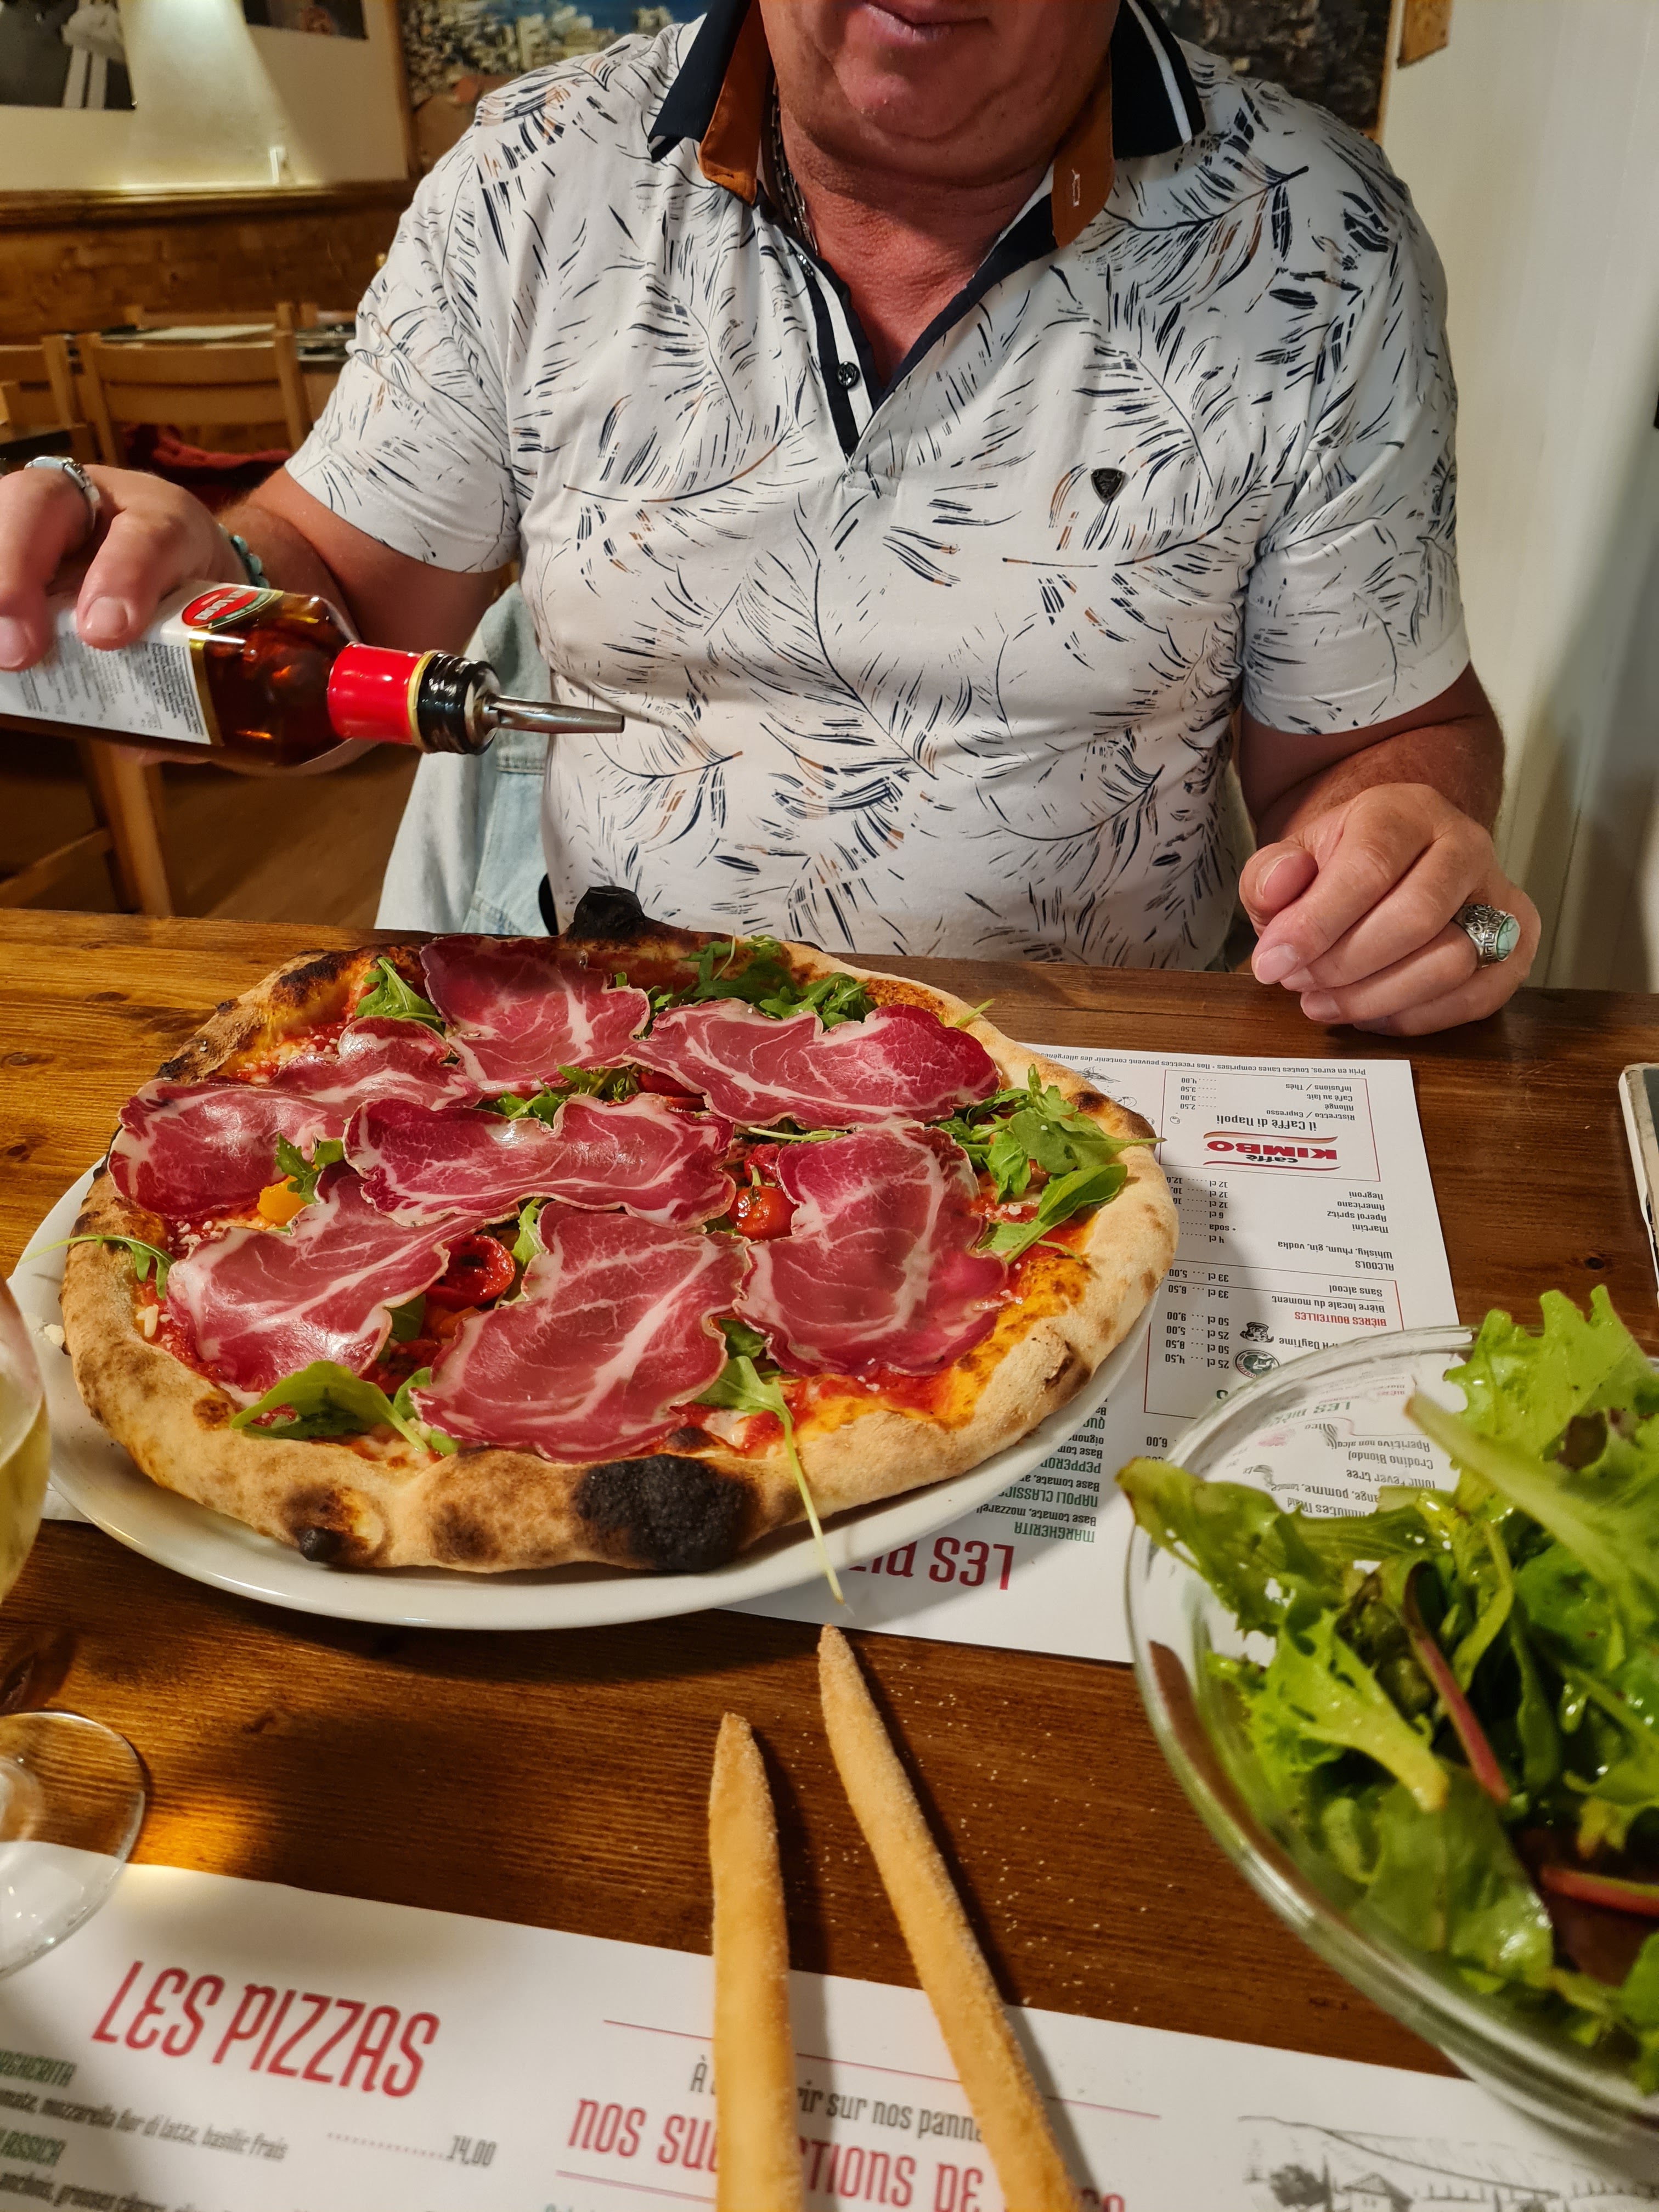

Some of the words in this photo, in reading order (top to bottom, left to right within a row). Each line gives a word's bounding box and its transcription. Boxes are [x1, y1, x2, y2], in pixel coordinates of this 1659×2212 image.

[1217, 1063, 1256, 1071] comprises
[1314, 1084, 1352, 1092] Infusions
[1324, 1103, 1354, 1111] Allongé
[1266, 1109, 1304, 1118] Expresso
[1314, 1113, 1355, 1121] Ristretto
[1216, 1115, 1254, 1126] Napoli
[1257, 1118, 1268, 1128] di
[1271, 1119, 1306, 1130] Caffè
[1309, 1122, 1317, 1131] il
[1207, 1141, 1337, 1160] KIMBO
[1245, 1154, 1298, 1163] caffè
[1348, 1191, 1384, 1200] Negroni
[1338, 1201, 1385, 1211] Americano
[1327, 1210, 1355, 1220] spritz
[1357, 1212, 1387, 1222] Aperol
[1352, 1223, 1389, 1233] Martini
[1278, 1241, 1305, 1249] vodka
[1355, 1261, 1393, 1271] ALCOOLS
[1169, 1268, 1187, 1279] 5,00
[1208, 1272, 1216, 1281] cl
[1218, 1274, 1229, 1282] 33
[1168, 1284, 1187, 1295] 6,50
[1208, 1289, 1216, 1298] cl
[1218, 1290, 1229, 1299] 33
[1329, 1284, 1357, 1295] alcool
[1358, 1287, 1383, 1297] Sans
[1272, 1296, 1311, 1307] moment
[1313, 1300, 1325, 1309] du
[1328, 1301, 1356, 1311] locale
[1358, 1304, 1385, 1313] Bière
[1167, 1311, 1186, 1321] 9,00
[1207, 1316, 1216, 1325] cl
[1218, 1317, 1229, 1325] 50
[1295, 1311, 1350, 1323] BOUTEILLES
[1352, 1317, 1387, 1328] BIÈRES
[1166, 1325, 1186, 1335] 5,00
[1207, 1329, 1216, 1339] cl
[1218, 1331, 1229, 1340] 25
[1165, 1339, 1185, 1350] 8,50
[1207, 1344, 1216, 1353] cl
[1279, 1338, 1319, 1350] DayTime
[1218, 1345, 1229, 1354] 50
[1165, 1353, 1185, 1364] 4,50
[1207, 1357, 1216, 1367] cl
[1218, 1359, 1229, 1369] 25
[1147, 1436, 1167, 1448] 6,00
[1080, 1448, 1103, 1459] Base
[1389, 1455, 1433, 1470] Crodino
[1346, 1469, 1371, 1482] tree
[1034, 1474, 1073, 1490] tomate,
[1076, 1480, 1099, 1492] Base
[1056, 1491, 1098, 1508] NAPOLI
[1029, 1509, 1070, 1523] tomate,
[1073, 1514, 1096, 1527] Base
[1014, 1521, 1095, 1544] MARGHERITA
[929, 1536, 1014, 1590] LES
[92, 1960, 225, 2058] LES
[211, 1983, 441, 2097] PIZZAS
[826, 2089, 867, 2119] sur
[871, 2101, 912, 2130] nos
[567, 2098, 647, 2158] NOS
